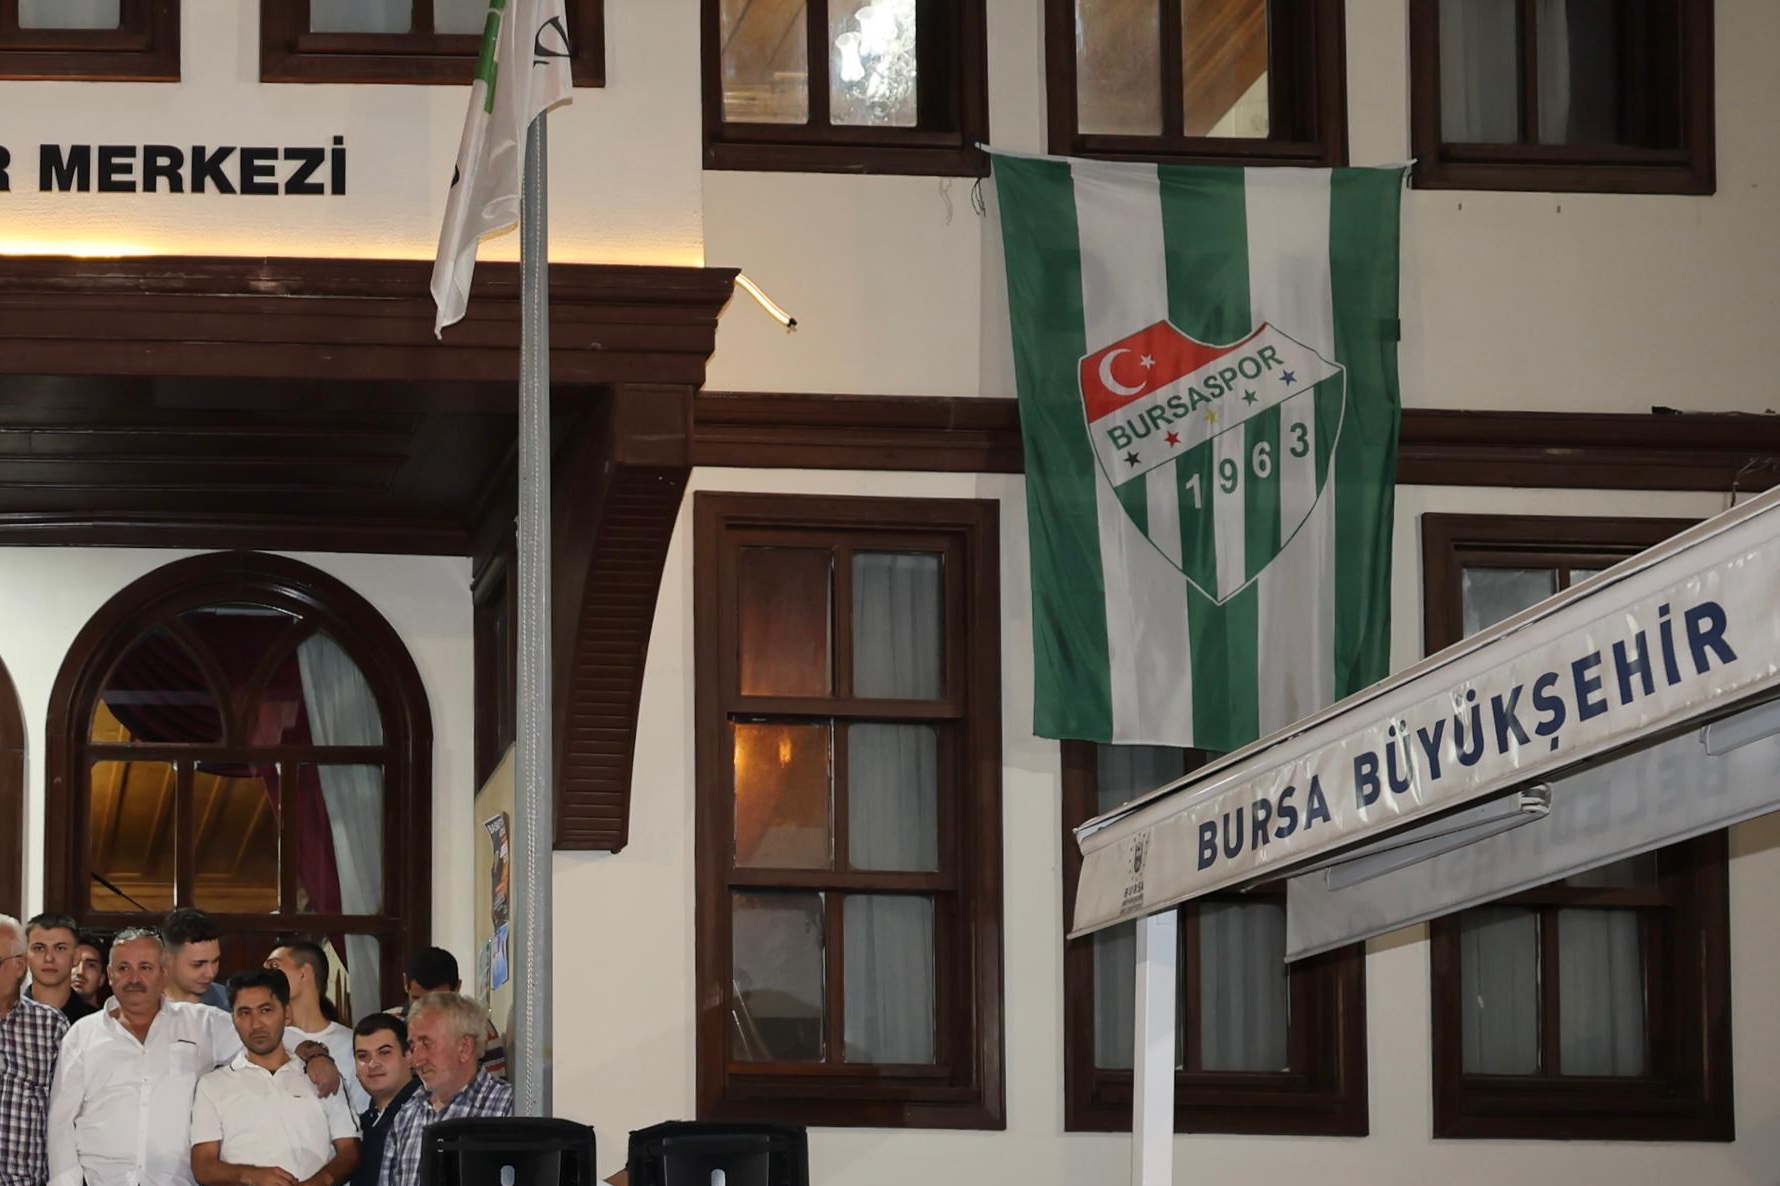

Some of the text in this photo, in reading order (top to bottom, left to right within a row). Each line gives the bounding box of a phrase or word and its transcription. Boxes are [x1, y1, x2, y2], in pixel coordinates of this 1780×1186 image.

[39, 135, 346, 195] MERKEZİ
[1106, 345, 1284, 450] BURSASPOR
[1186, 422, 1309, 509] 1963
[1197, 600, 1738, 872] BURSA BÜYÜKŞEHİR
